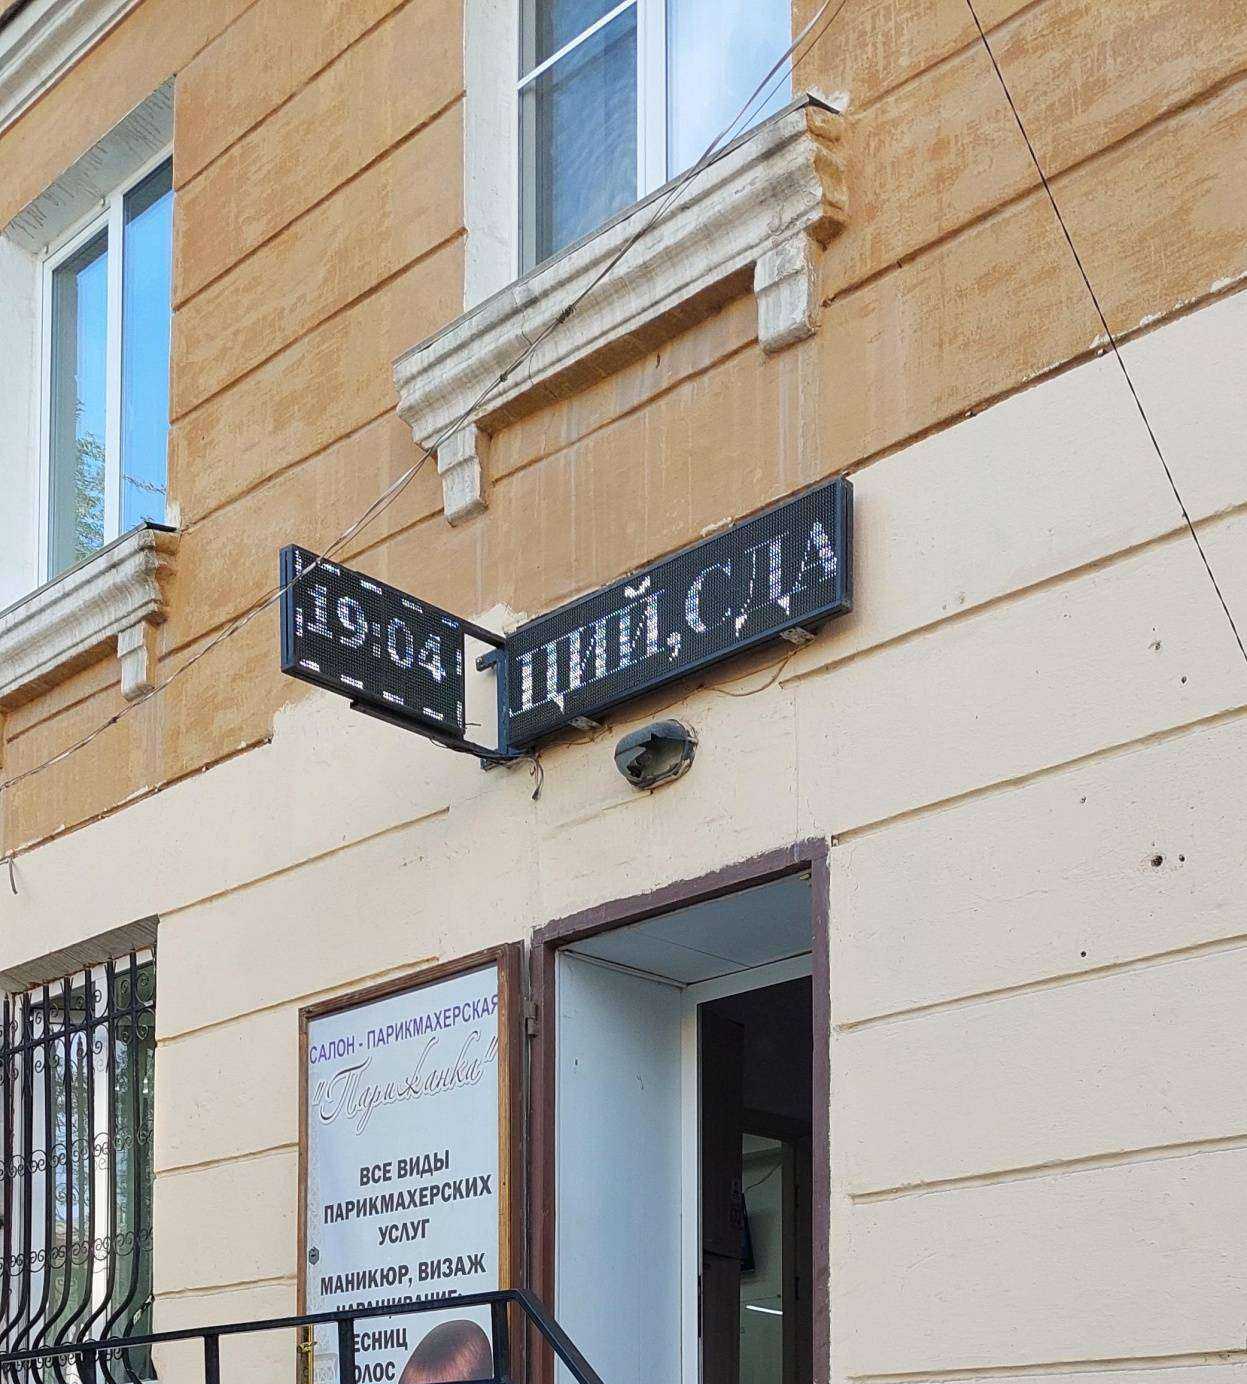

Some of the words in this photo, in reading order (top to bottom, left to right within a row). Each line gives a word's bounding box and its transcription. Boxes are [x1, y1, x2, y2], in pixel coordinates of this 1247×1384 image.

[307, 584, 447, 683] 19:04
[310, 1036, 355, 1064] САЛОН
[367, 994, 498, 1050] ПАРИКМАХЕРСКАЯ
[360, 1162, 392, 1187] ВСЕ
[397, 1150, 450, 1179] ВИДЫ
[324, 1174, 492, 1224] ПАРИКМАХЕРСКИХ
[378, 1218, 430, 1245] УСЛУГ
[320, 1264, 413, 1296] МАНИКЮР,
[418, 1252, 487, 1283] ВИЗАЖ
[354, 1328, 408, 1352] ЕСНИЦ
